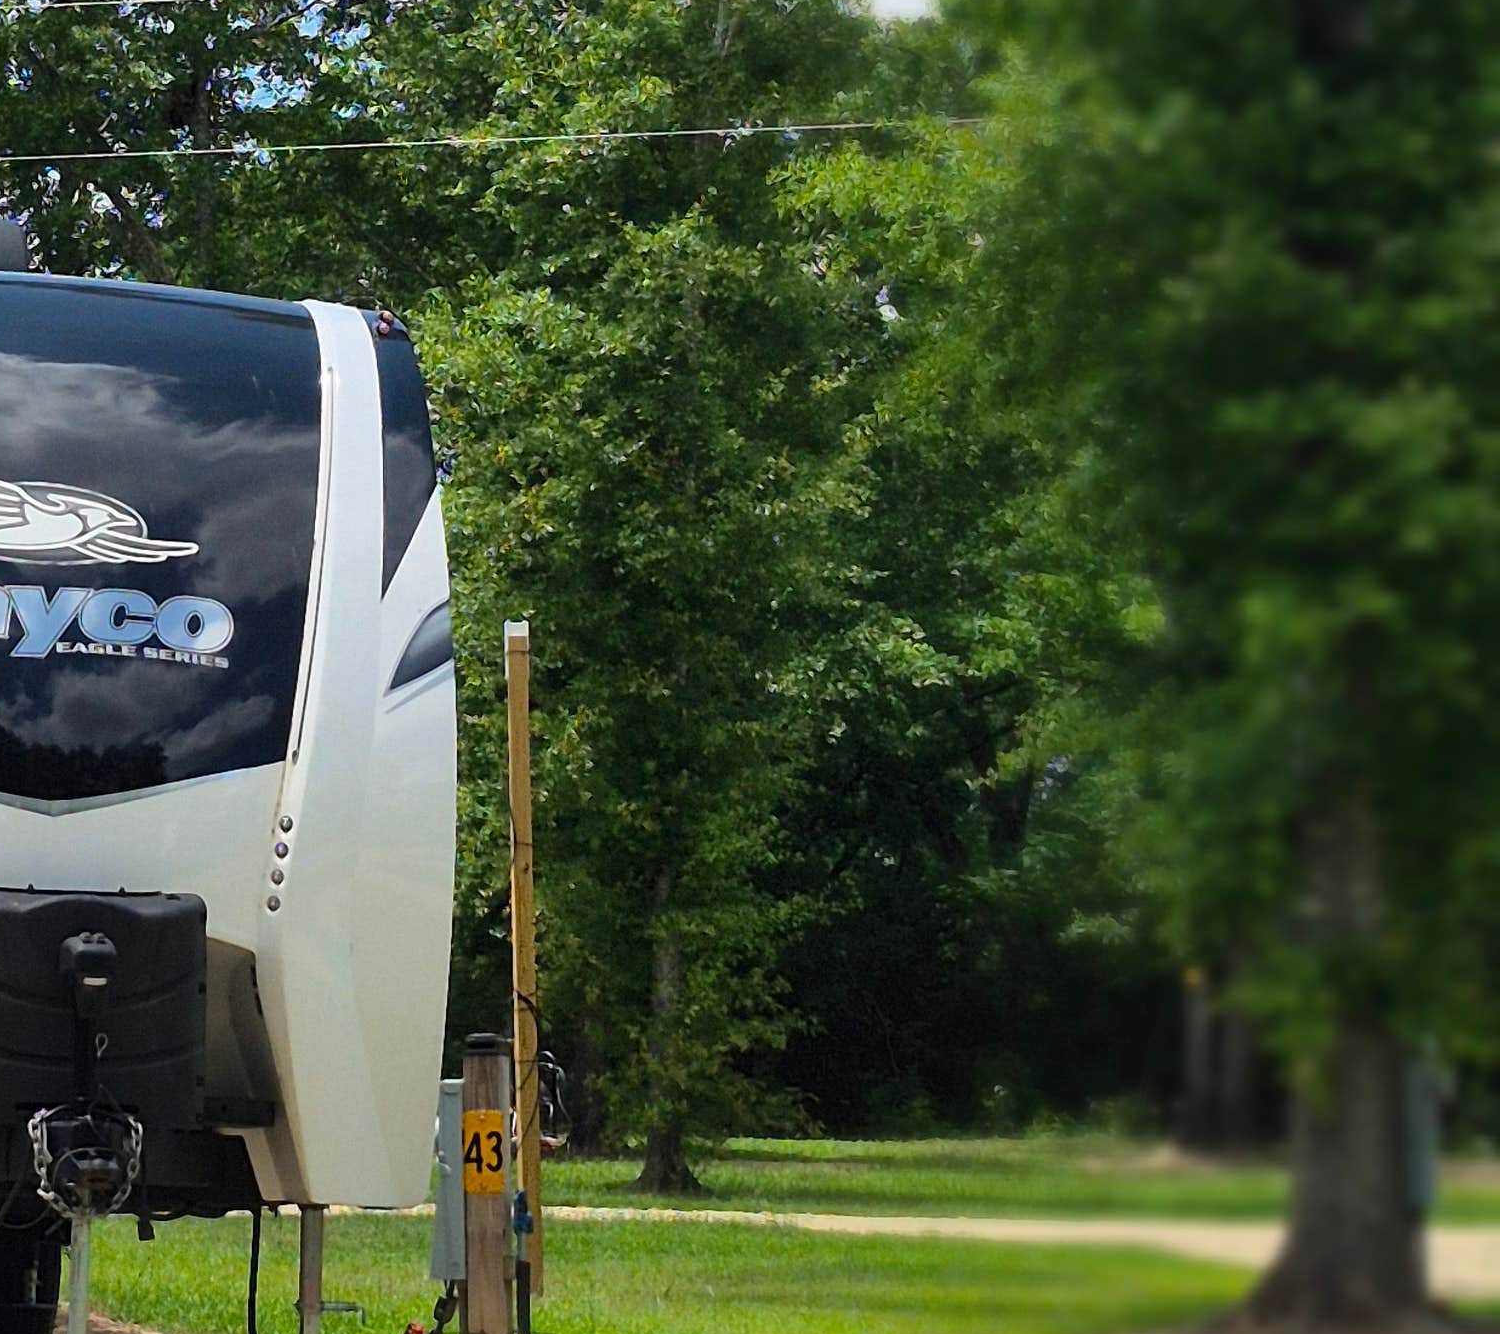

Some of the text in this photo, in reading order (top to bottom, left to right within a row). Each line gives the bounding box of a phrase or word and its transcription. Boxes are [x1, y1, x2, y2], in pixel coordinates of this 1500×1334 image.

[56, 641, 229, 669] EAGLE SERIES
[464, 1131, 503, 1173] 43
